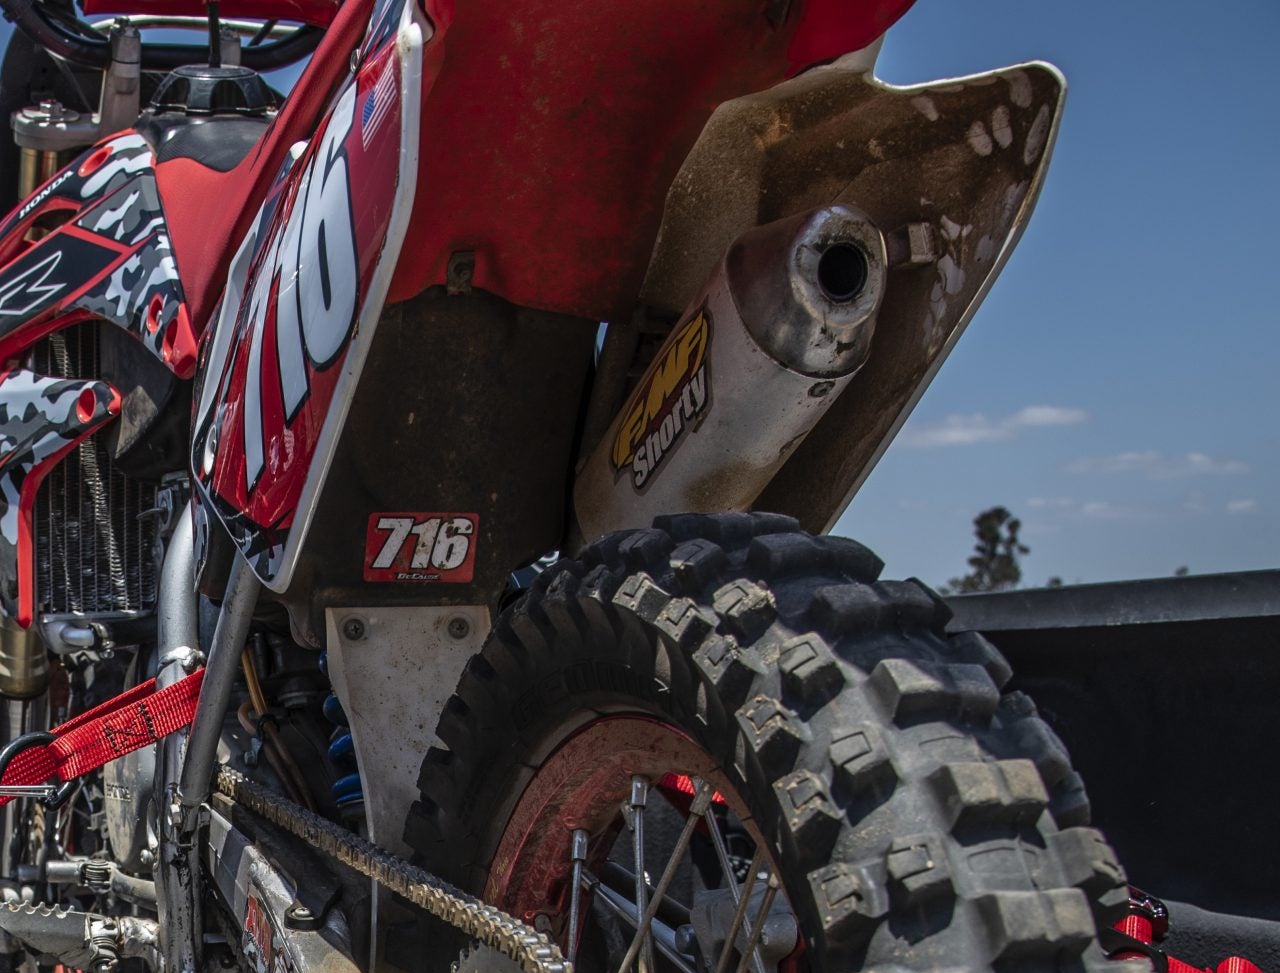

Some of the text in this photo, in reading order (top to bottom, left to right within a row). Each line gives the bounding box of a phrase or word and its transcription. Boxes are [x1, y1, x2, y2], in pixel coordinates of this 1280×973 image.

[19, 170, 75, 219] HONDA
[613, 310, 709, 469] FMF
[370, 516, 475, 571] 716
